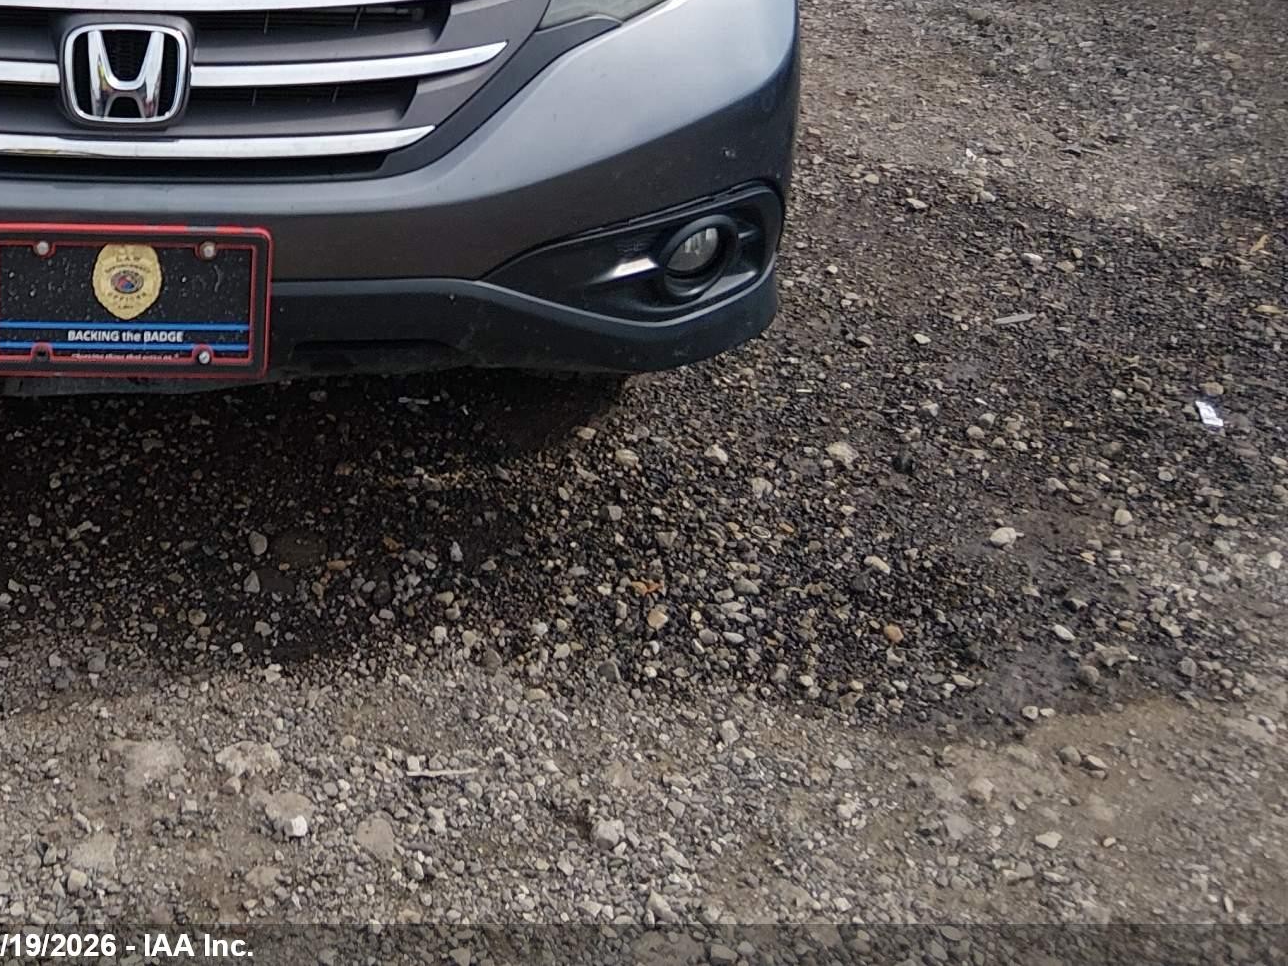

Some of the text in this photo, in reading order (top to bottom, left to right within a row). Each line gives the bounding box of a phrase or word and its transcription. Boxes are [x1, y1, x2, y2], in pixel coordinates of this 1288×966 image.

[67, 330, 184, 343] BACKING the BADGE
